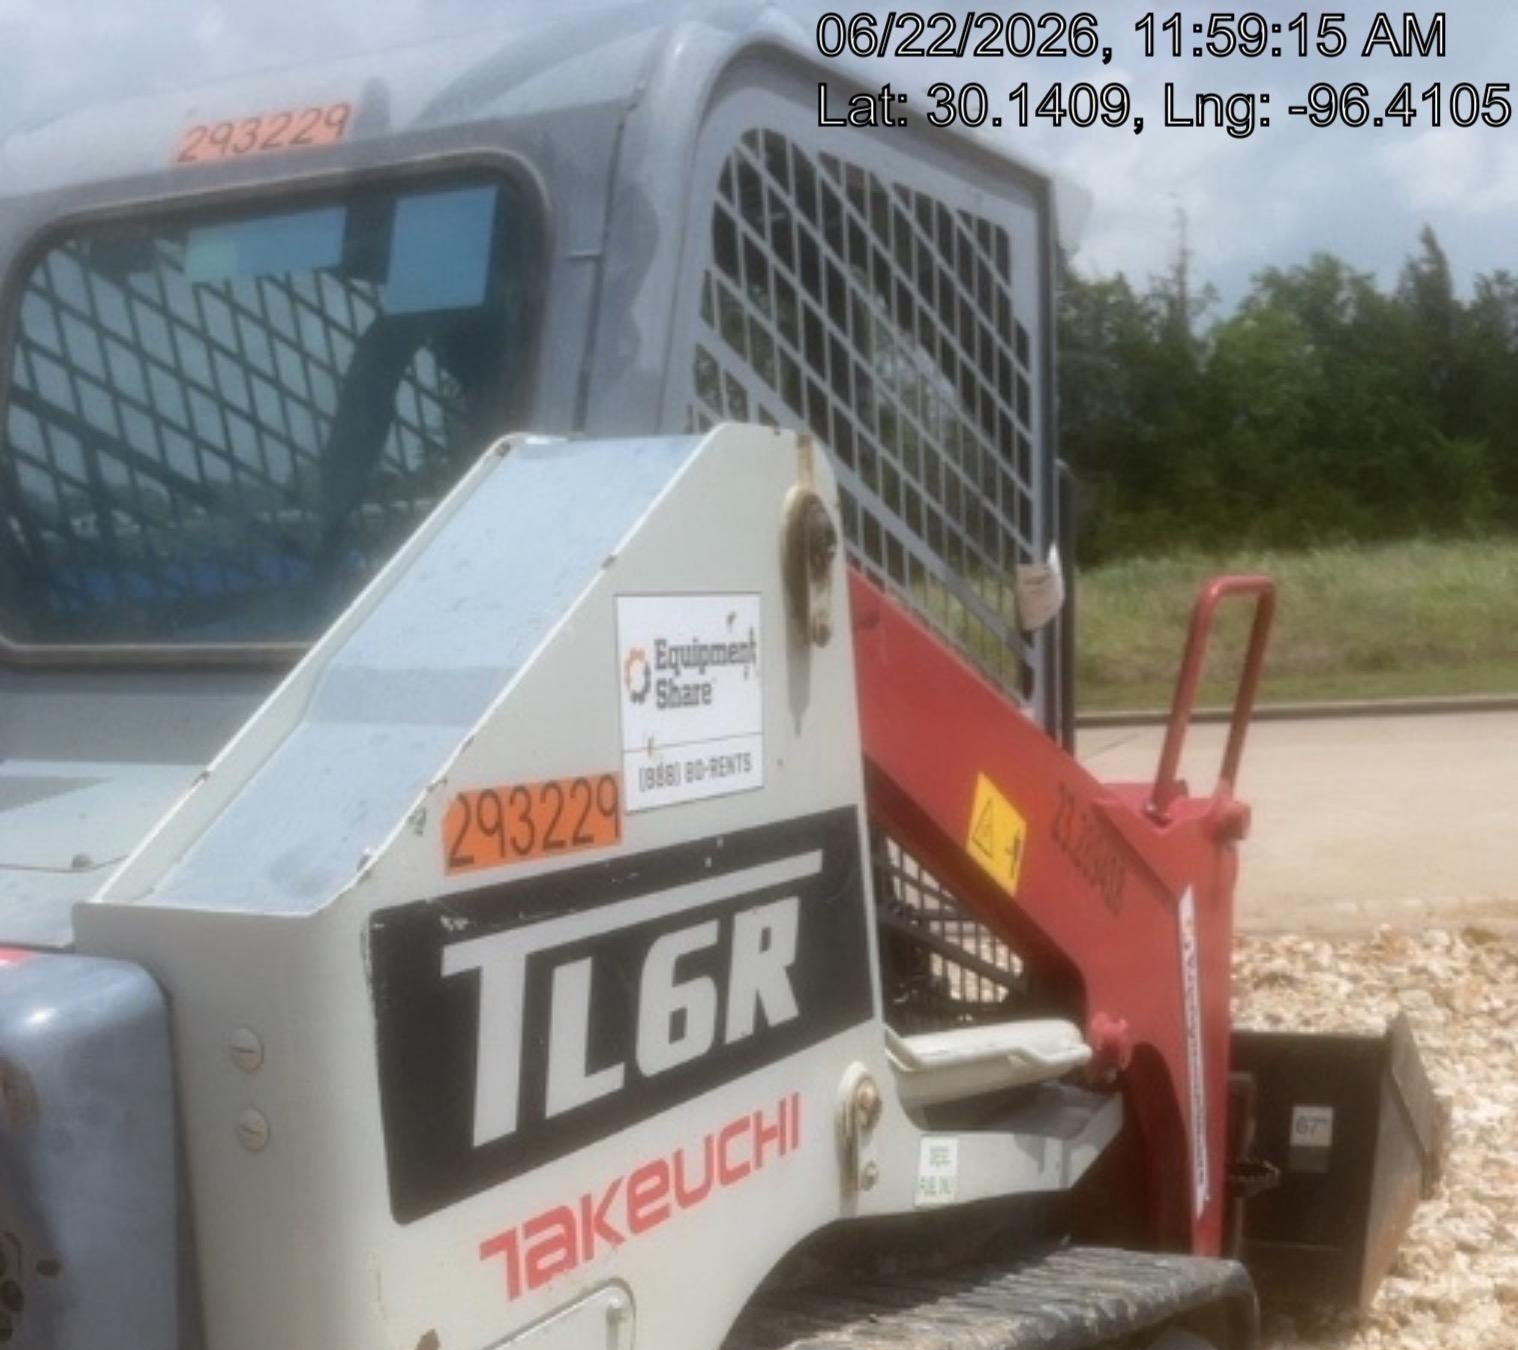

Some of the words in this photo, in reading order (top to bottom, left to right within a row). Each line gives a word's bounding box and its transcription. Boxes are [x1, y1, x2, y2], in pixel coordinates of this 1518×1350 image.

[176, 102, 351, 163] 293229
[653, 636, 757, 676] Equipment
[655, 677, 713, 711] Share
[447, 773, 620, 868] 293229
[440, 849, 823, 1149] TL6R
